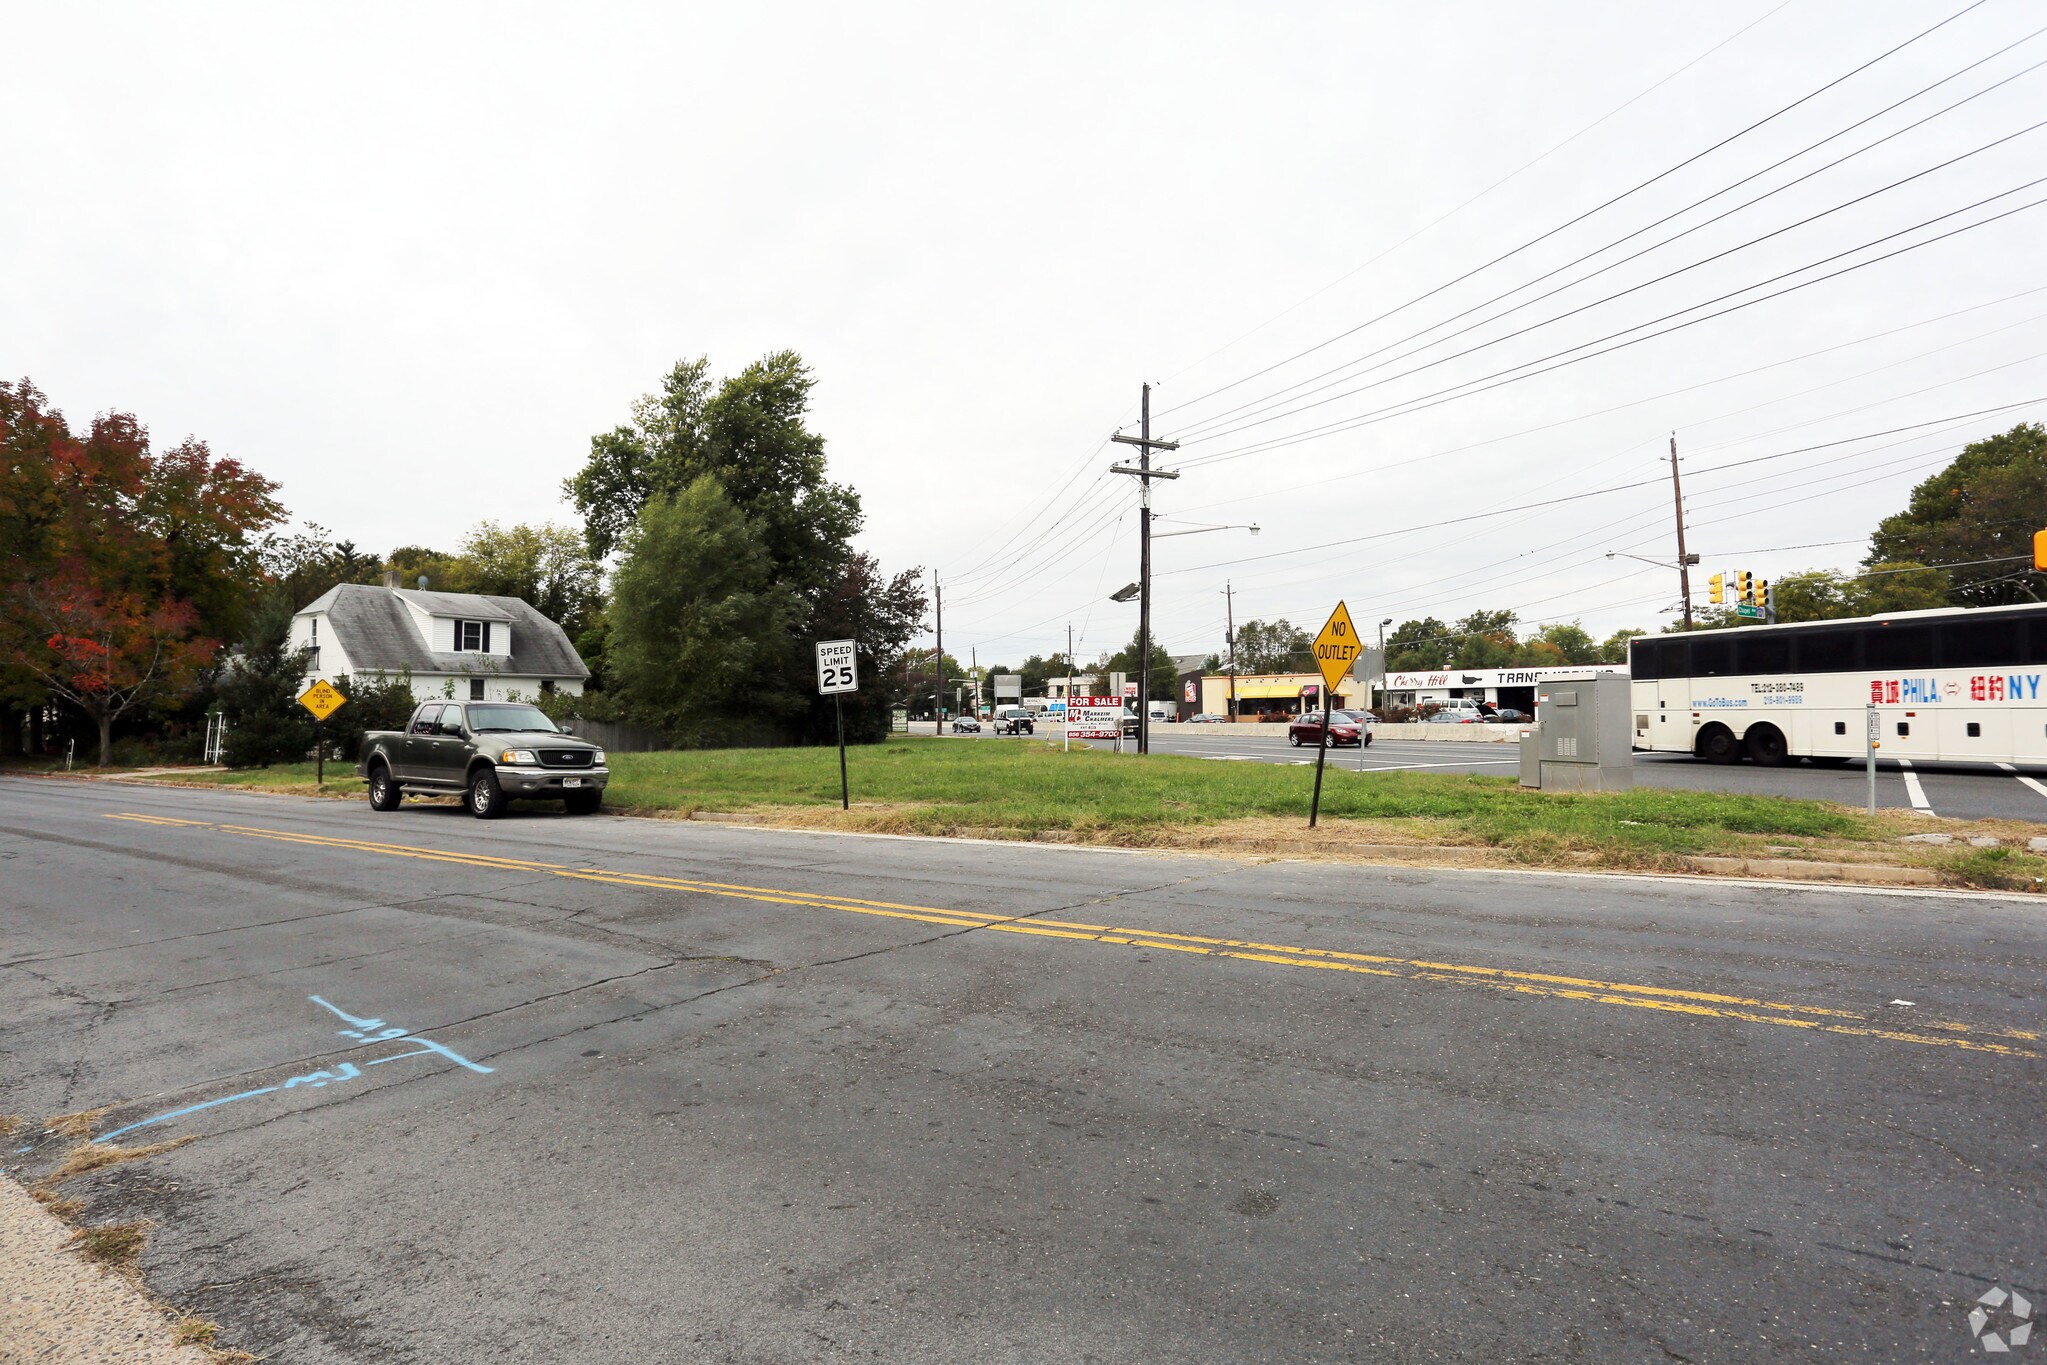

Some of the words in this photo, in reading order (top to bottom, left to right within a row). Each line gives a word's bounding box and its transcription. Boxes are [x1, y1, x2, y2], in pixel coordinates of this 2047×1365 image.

[1331, 621, 1346, 637] NO
[820, 646, 852, 656] SPEED
[1318, 644, 1355, 660] OUTLET
[823, 656, 849, 666] LIMIT
[822, 666, 853, 687] 25
[1394, 675, 1423, 687] Cherry
[1427, 675, 1448, 686] Hill
[1902, 678, 1942, 703] PHILA.
[1970, 676, 2004, 701] 紐約
[2009, 675, 2040, 699] NY
[1069, 697, 1090, 706] FOR
[1093, 697, 1119, 706] SALE
